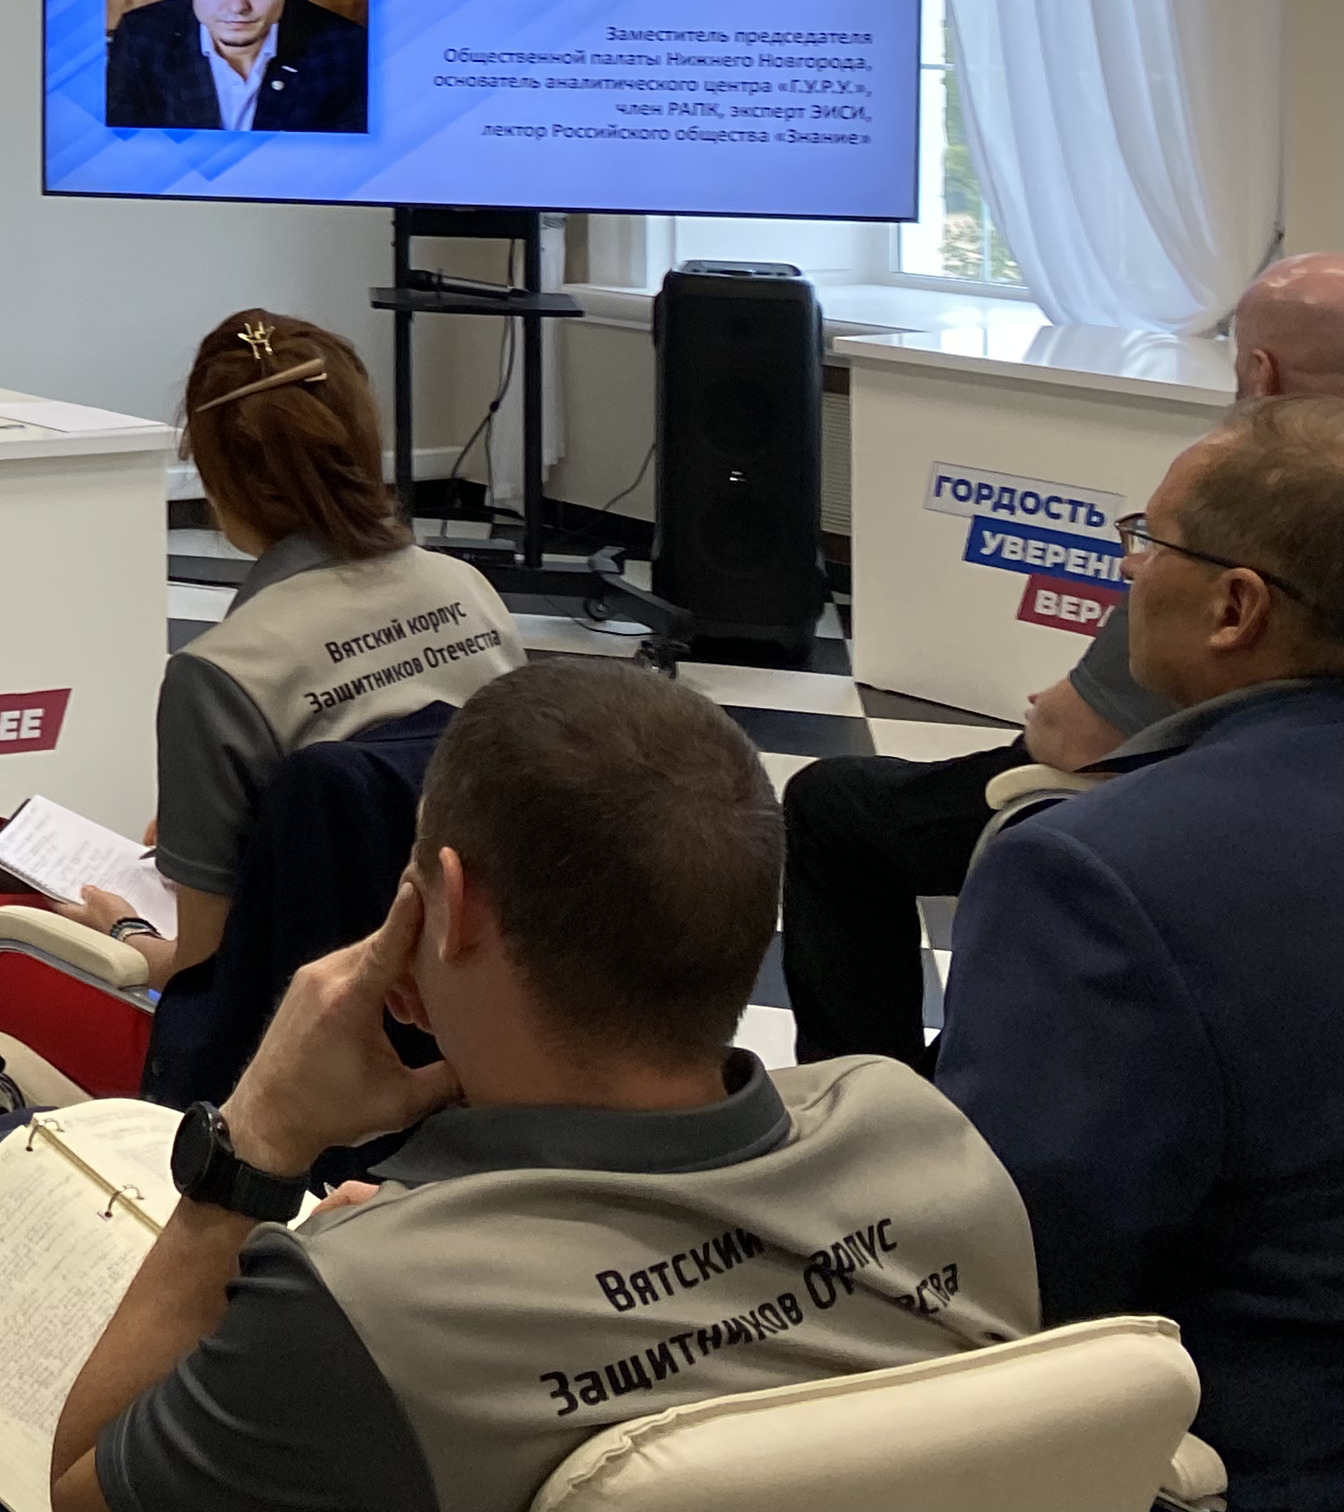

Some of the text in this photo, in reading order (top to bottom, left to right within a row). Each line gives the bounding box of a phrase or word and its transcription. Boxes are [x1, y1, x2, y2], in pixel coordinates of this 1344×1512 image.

[606, 26, 873, 47] Заместитель председателя
[443, 48, 873, 72] Общественной палаты Нижнего Новгорода,
[433, 74, 873, 97] основатель аналитического центра «Г.У.Р.У.»,
[616, 101, 872, 123] член РАПК, эксперт ЭИСИ,
[481, 124, 871, 146] лектор Российского общества «Знание»
[934, 475, 1106, 528] ГОРДОСТЬ
[325, 602, 466, 663] Вятский корпус
[304, 657, 424, 714] Защитников
[808, 1218, 897, 1296] орпус
[539, 1292, 804, 1416] Защитников
